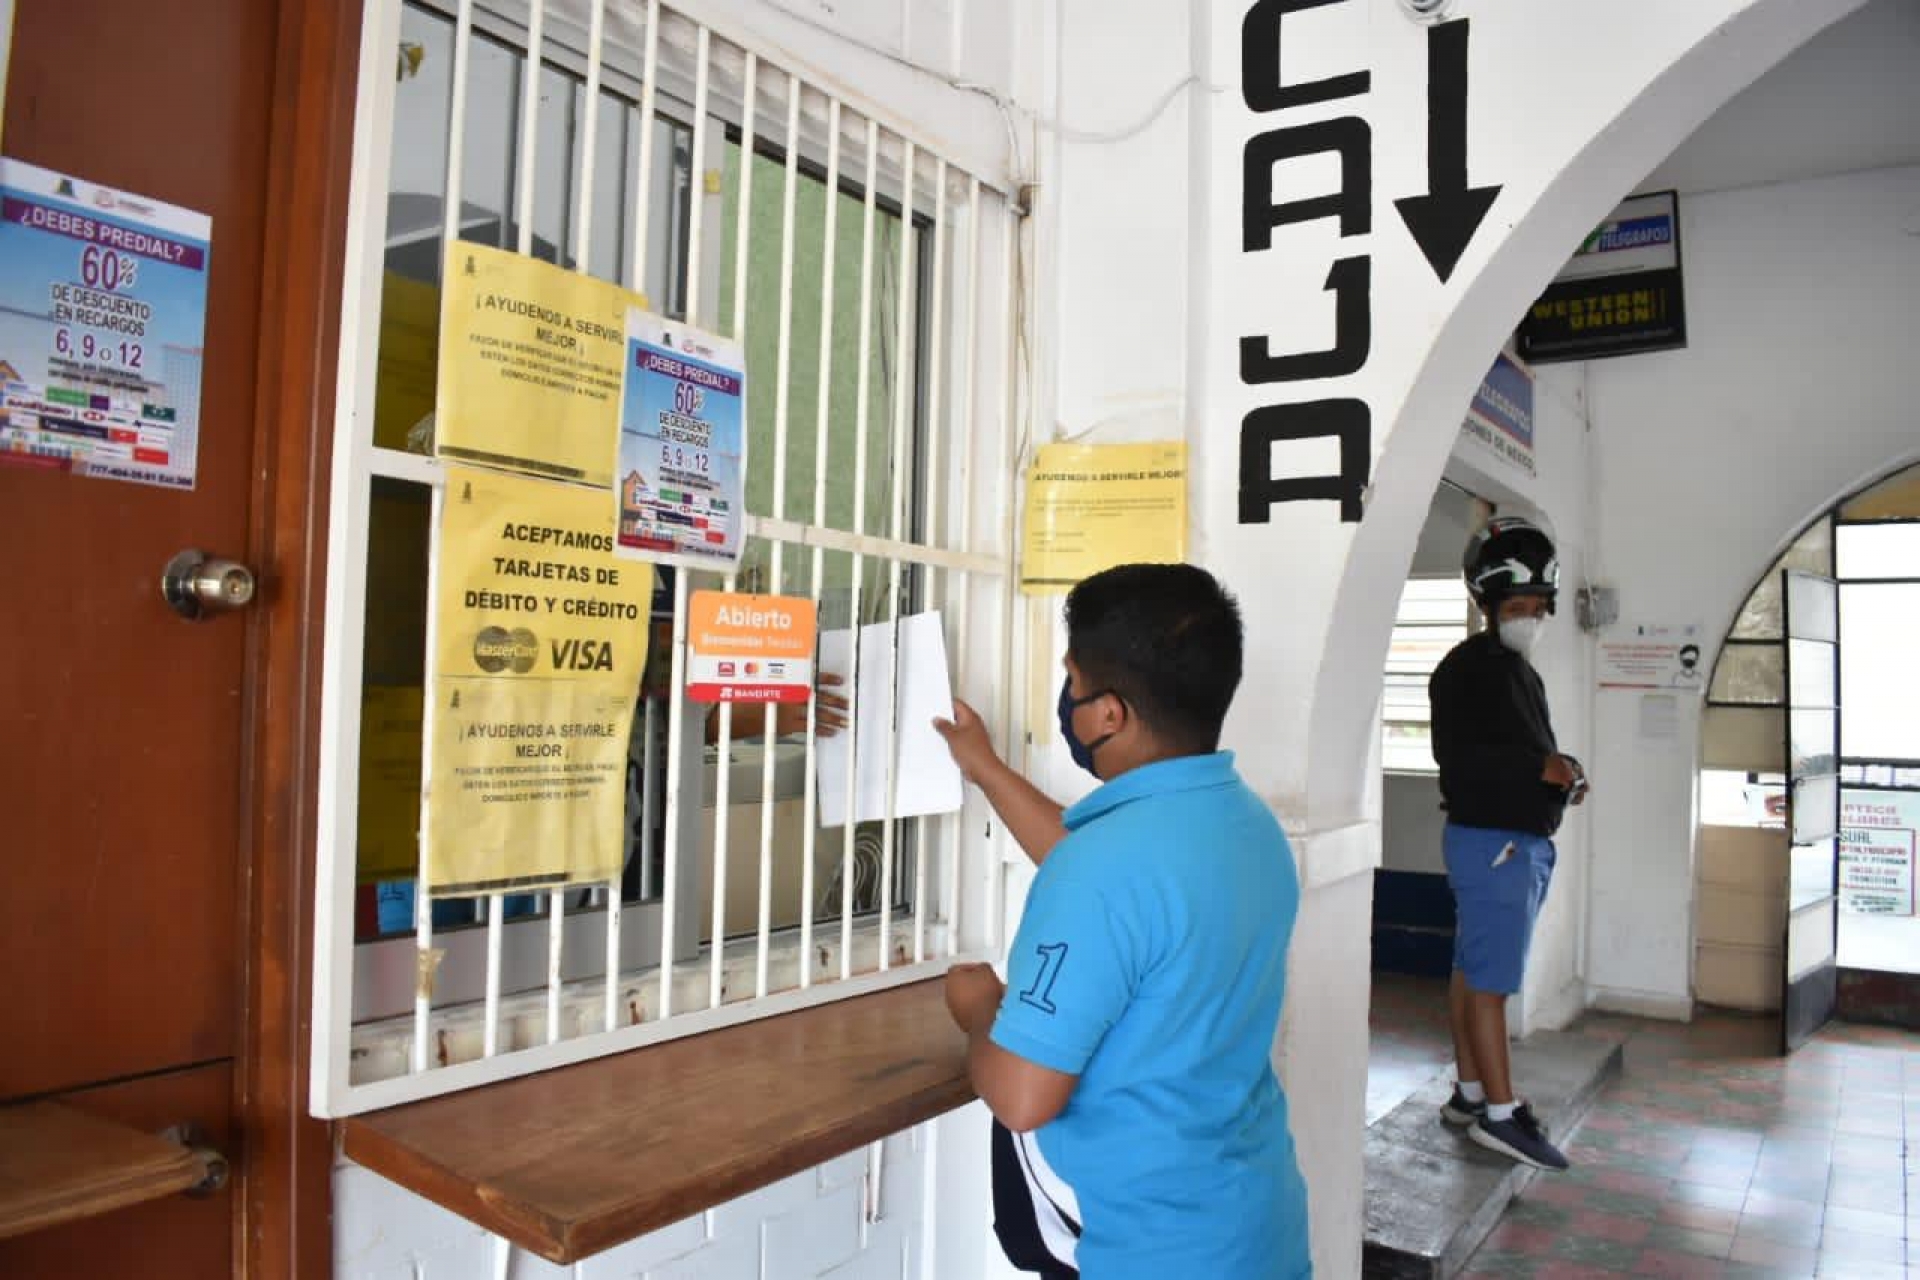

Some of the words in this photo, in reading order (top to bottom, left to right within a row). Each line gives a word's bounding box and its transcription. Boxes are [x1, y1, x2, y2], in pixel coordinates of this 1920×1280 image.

[21, 206, 94, 240] ¿DEBES
[100, 222, 184, 261] PREDIAL?
[82, 245, 137, 291] 60%
[1239, 0, 1371, 524] CAJA
[52, 284, 69, 301] DE
[72, 287, 150, 320] DESCUENTO
[1534, 290, 1649, 320] WESTERN
[55, 304, 73, 323] EN
[76, 309, 145, 337] RECARGOS
[486, 295, 562, 326] AYUDENOS
[563, 316, 572, 329] A
[576, 319, 624, 346] SERVIRL
[1572, 308, 1649, 330] UNION
[82, 334, 95, 359] 9
[119, 343, 142, 368] 12
[537, 327, 577, 350] MEJOR
[684, 366, 730, 389] PREDIAL?
[696, 454, 708, 471] 12
[503, 523, 614, 552] ACEPTAMOS
[493, 557, 591, 583] TARJETAS
[597, 568, 619, 586] DE
[465, 588, 538, 613] DÉBITO
[545, 597, 558, 613] Y
[563, 597, 638, 620] CRÉDITO
[714, 605, 793, 631] Abierto
[551, 639, 613, 671] VISA
[467, 723, 543, 738] AYUDENOS
[546, 724, 555, 737] A
[560, 723, 615, 738] SERVIRLE
[516, 744, 562, 757] MEJOR
[1020, 942, 1068, 1014] 1
